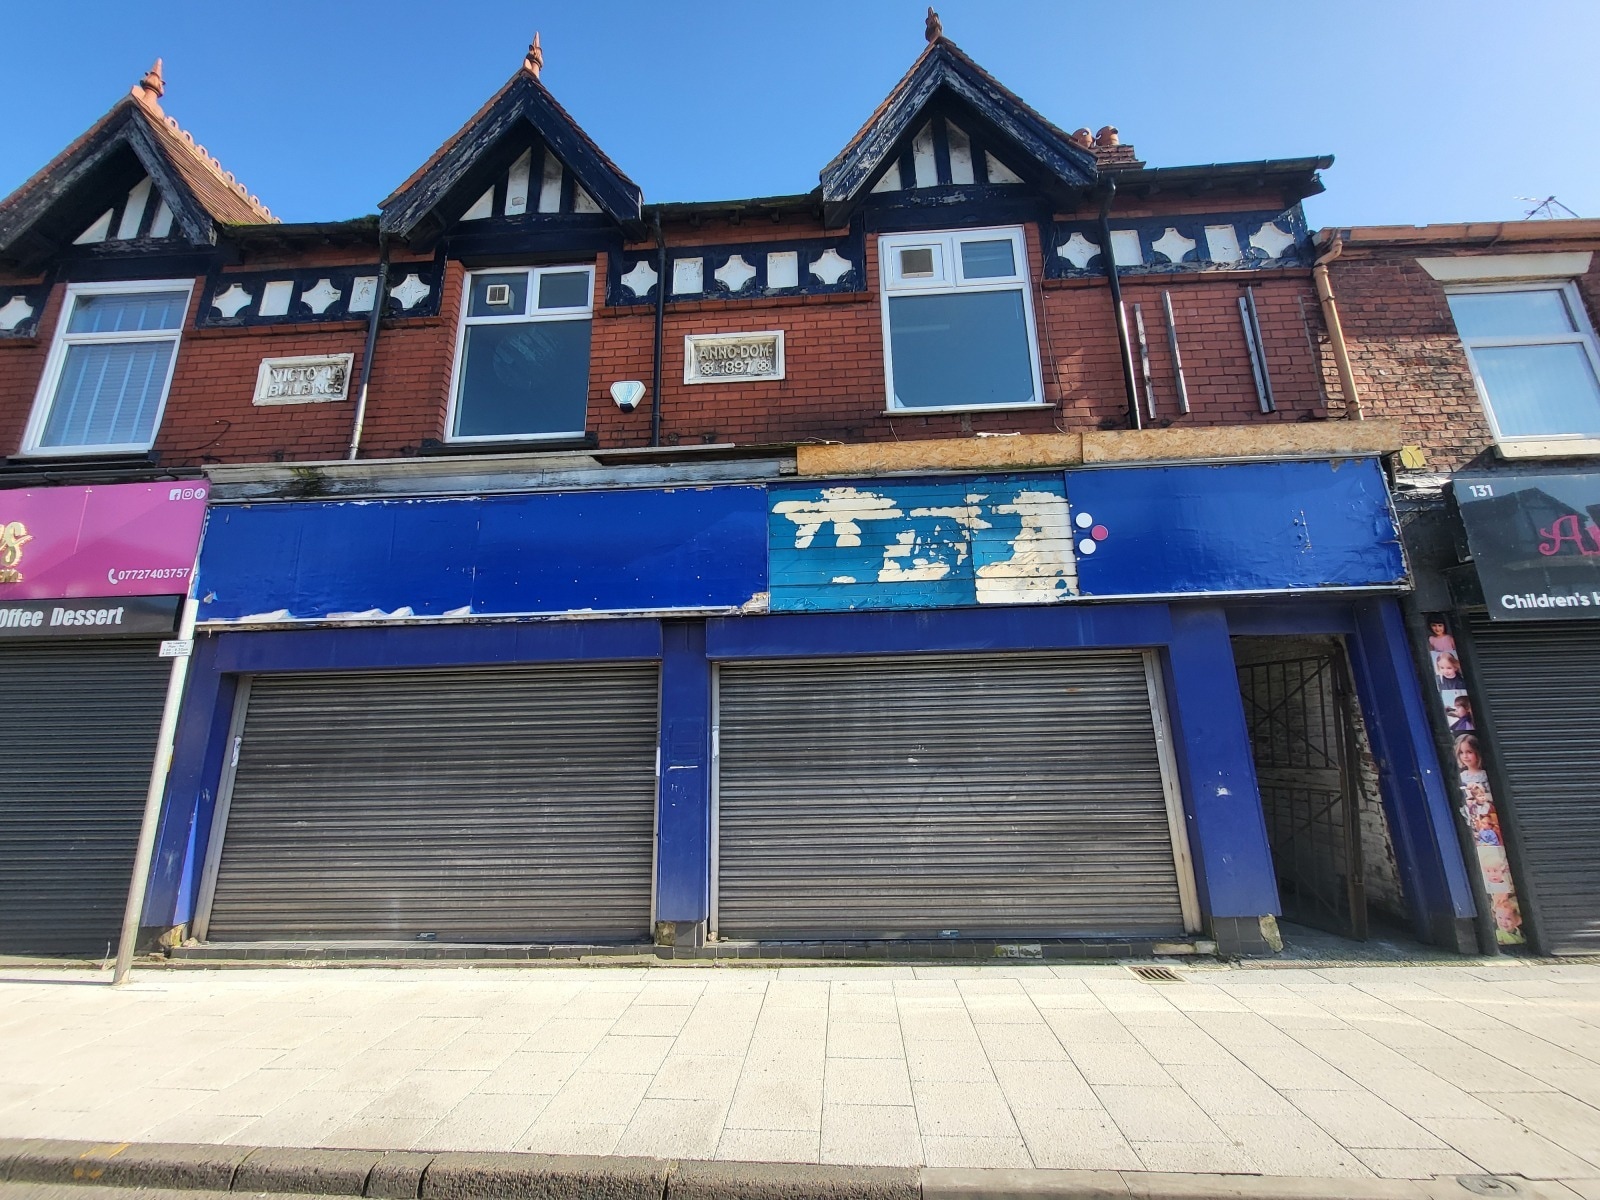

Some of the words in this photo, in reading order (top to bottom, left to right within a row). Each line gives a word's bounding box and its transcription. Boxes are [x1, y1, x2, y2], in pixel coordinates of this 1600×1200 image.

[272, 366, 344, 383] VICTOIA
[720, 359, 753, 374] 1897
[1469, 484, 1493, 498] 131
[118, 567, 190, 581] 07727403757
[1501, 592, 1590, 610] Children's
[50, 606, 124, 627] Dessert
